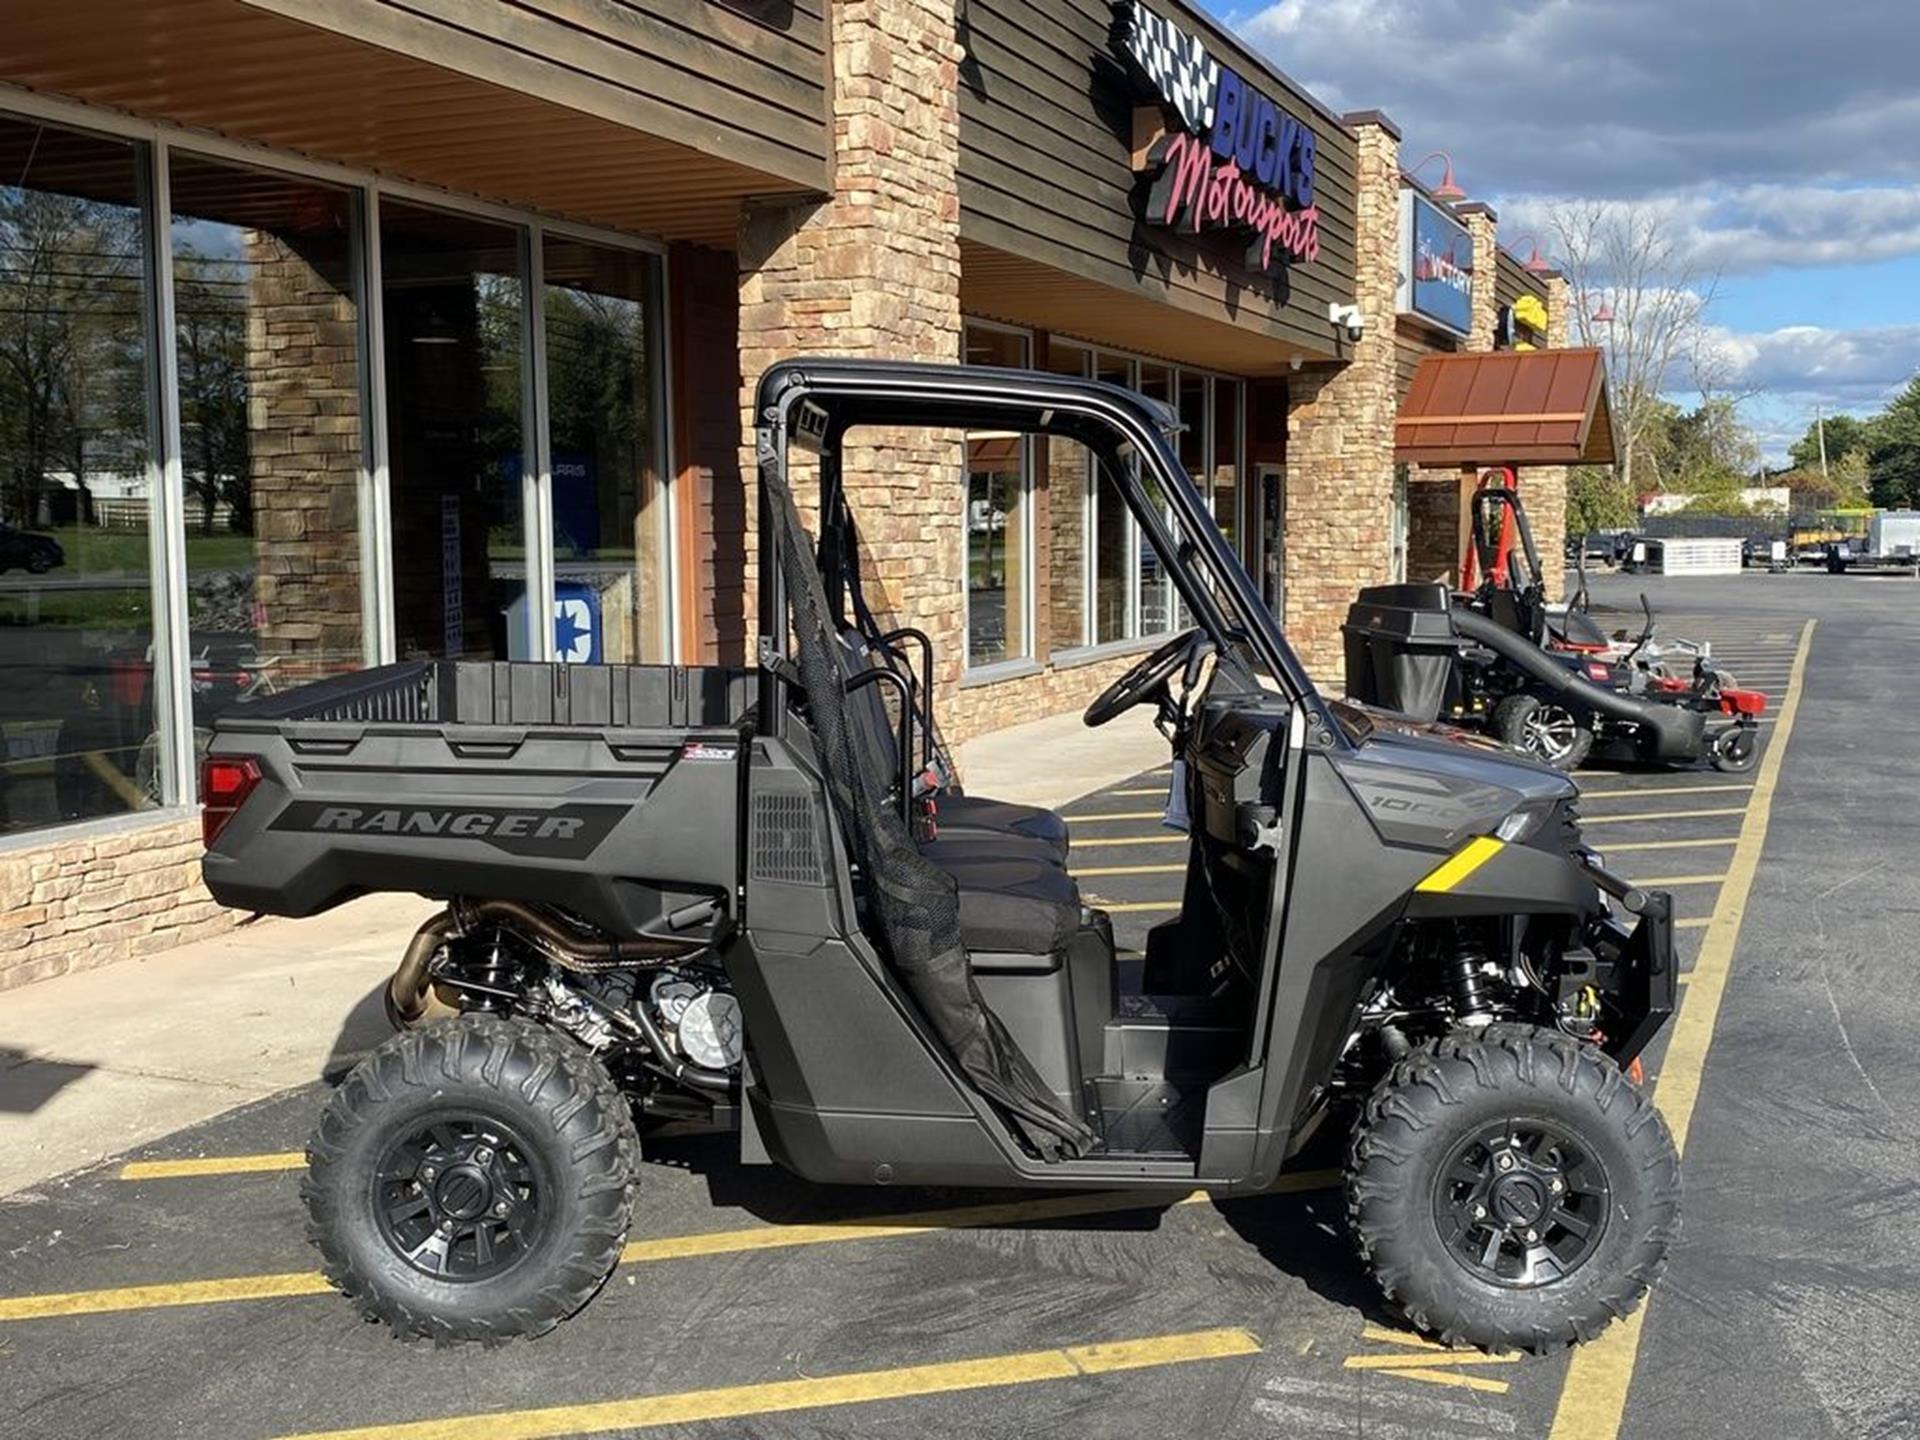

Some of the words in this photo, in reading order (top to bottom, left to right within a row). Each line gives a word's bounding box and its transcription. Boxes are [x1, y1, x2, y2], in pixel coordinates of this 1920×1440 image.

[1165, 132, 1320, 270] Motorsports
[1211, 66, 1316, 207] BUCK'S
[312, 807, 585, 839] RANGER
